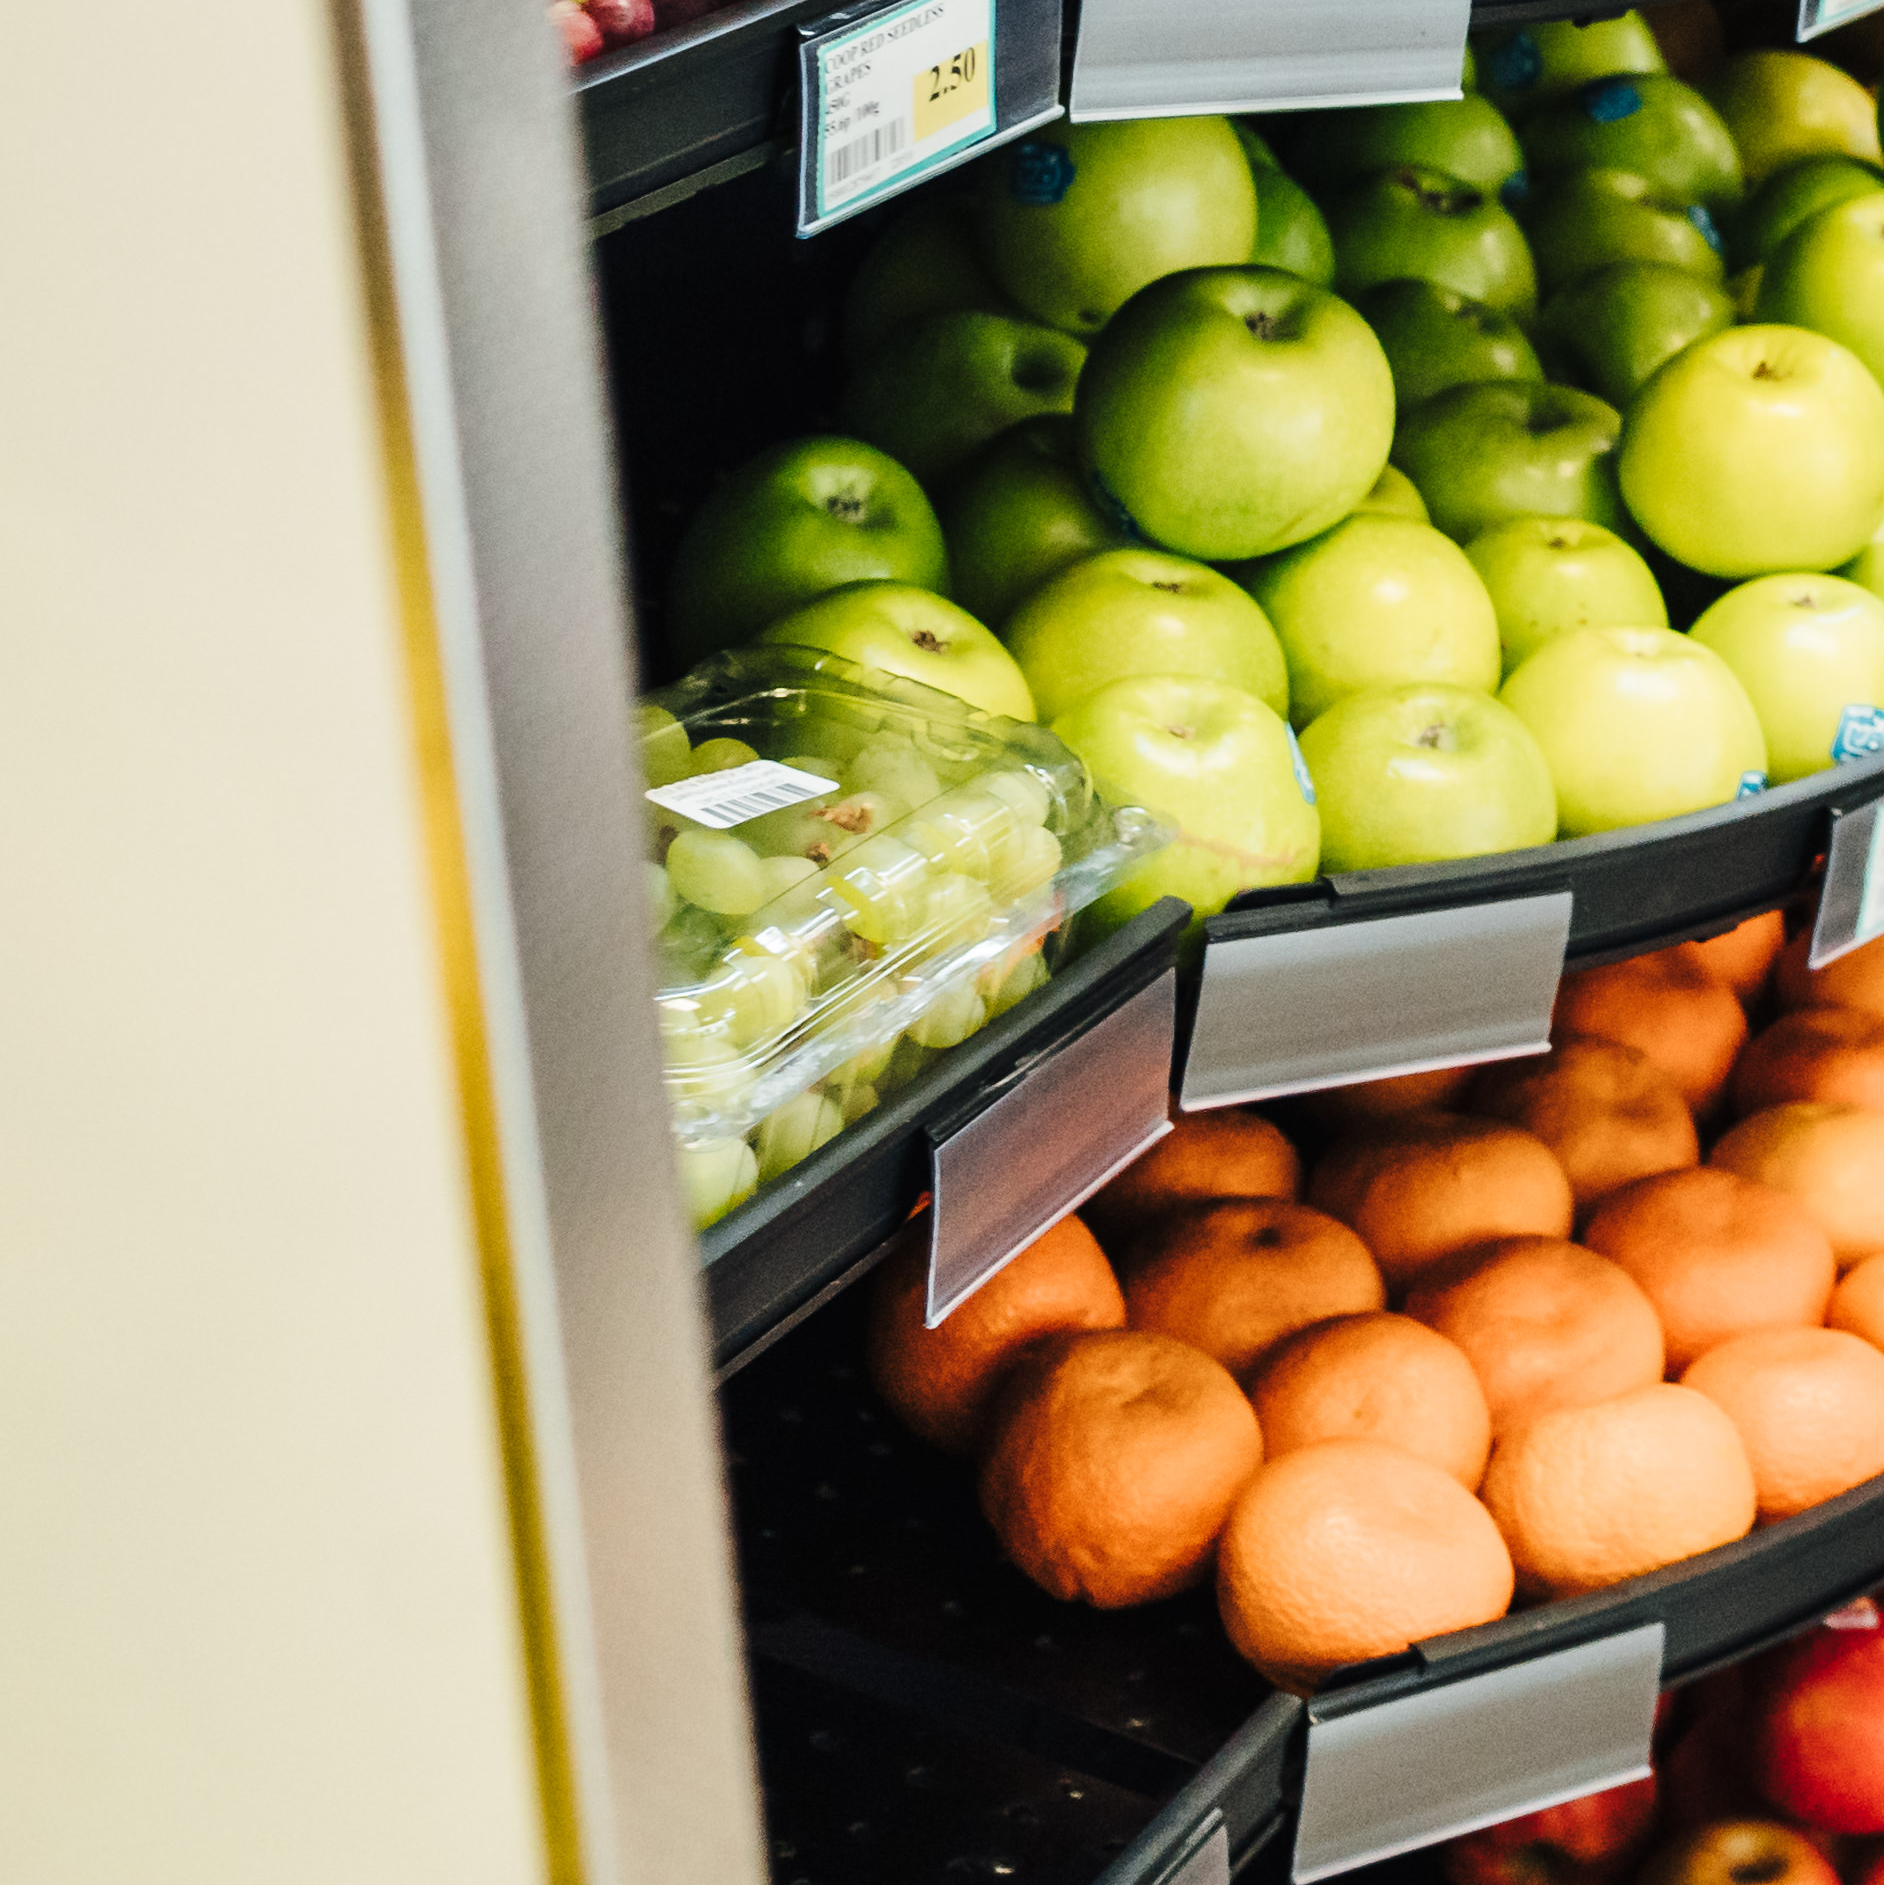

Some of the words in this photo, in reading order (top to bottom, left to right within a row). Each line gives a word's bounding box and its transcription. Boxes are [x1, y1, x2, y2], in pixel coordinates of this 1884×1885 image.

[861, 31, 885, 57] RED
[888, 3, 945, 40] SEEDLESS
[826, 62, 870, 92] GRAPES
[929, 46, 975, 101] 2.50
